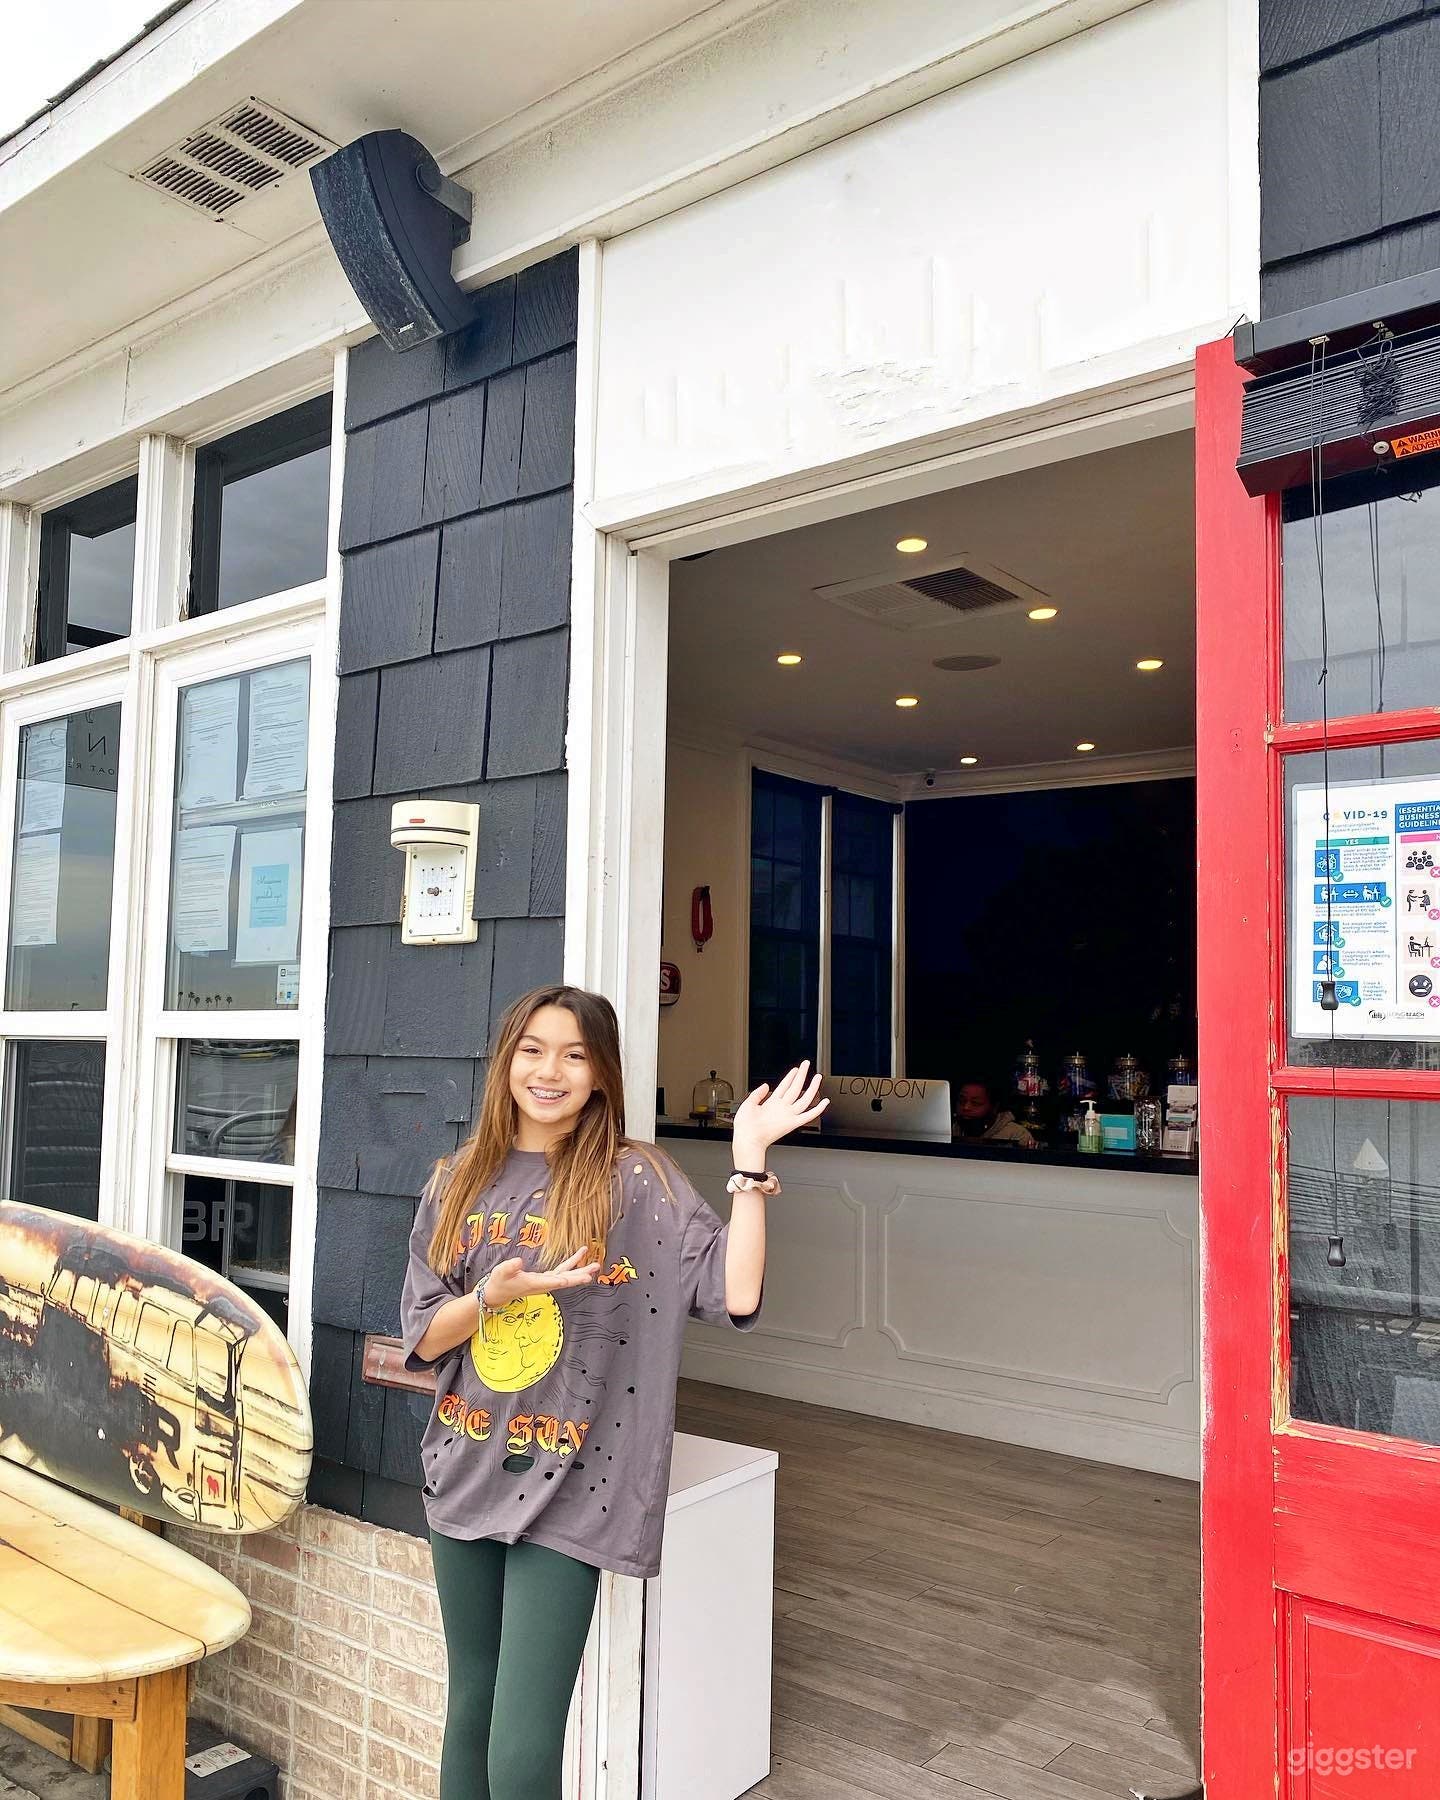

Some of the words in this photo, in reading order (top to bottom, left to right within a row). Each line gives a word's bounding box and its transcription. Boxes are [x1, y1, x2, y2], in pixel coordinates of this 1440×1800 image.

[1399, 812, 1440, 821] BUSINESS
[839, 1077, 927, 1099] LONDON
[437, 1392, 492, 1442] THE
[505, 1413, 590, 1459] SUN
